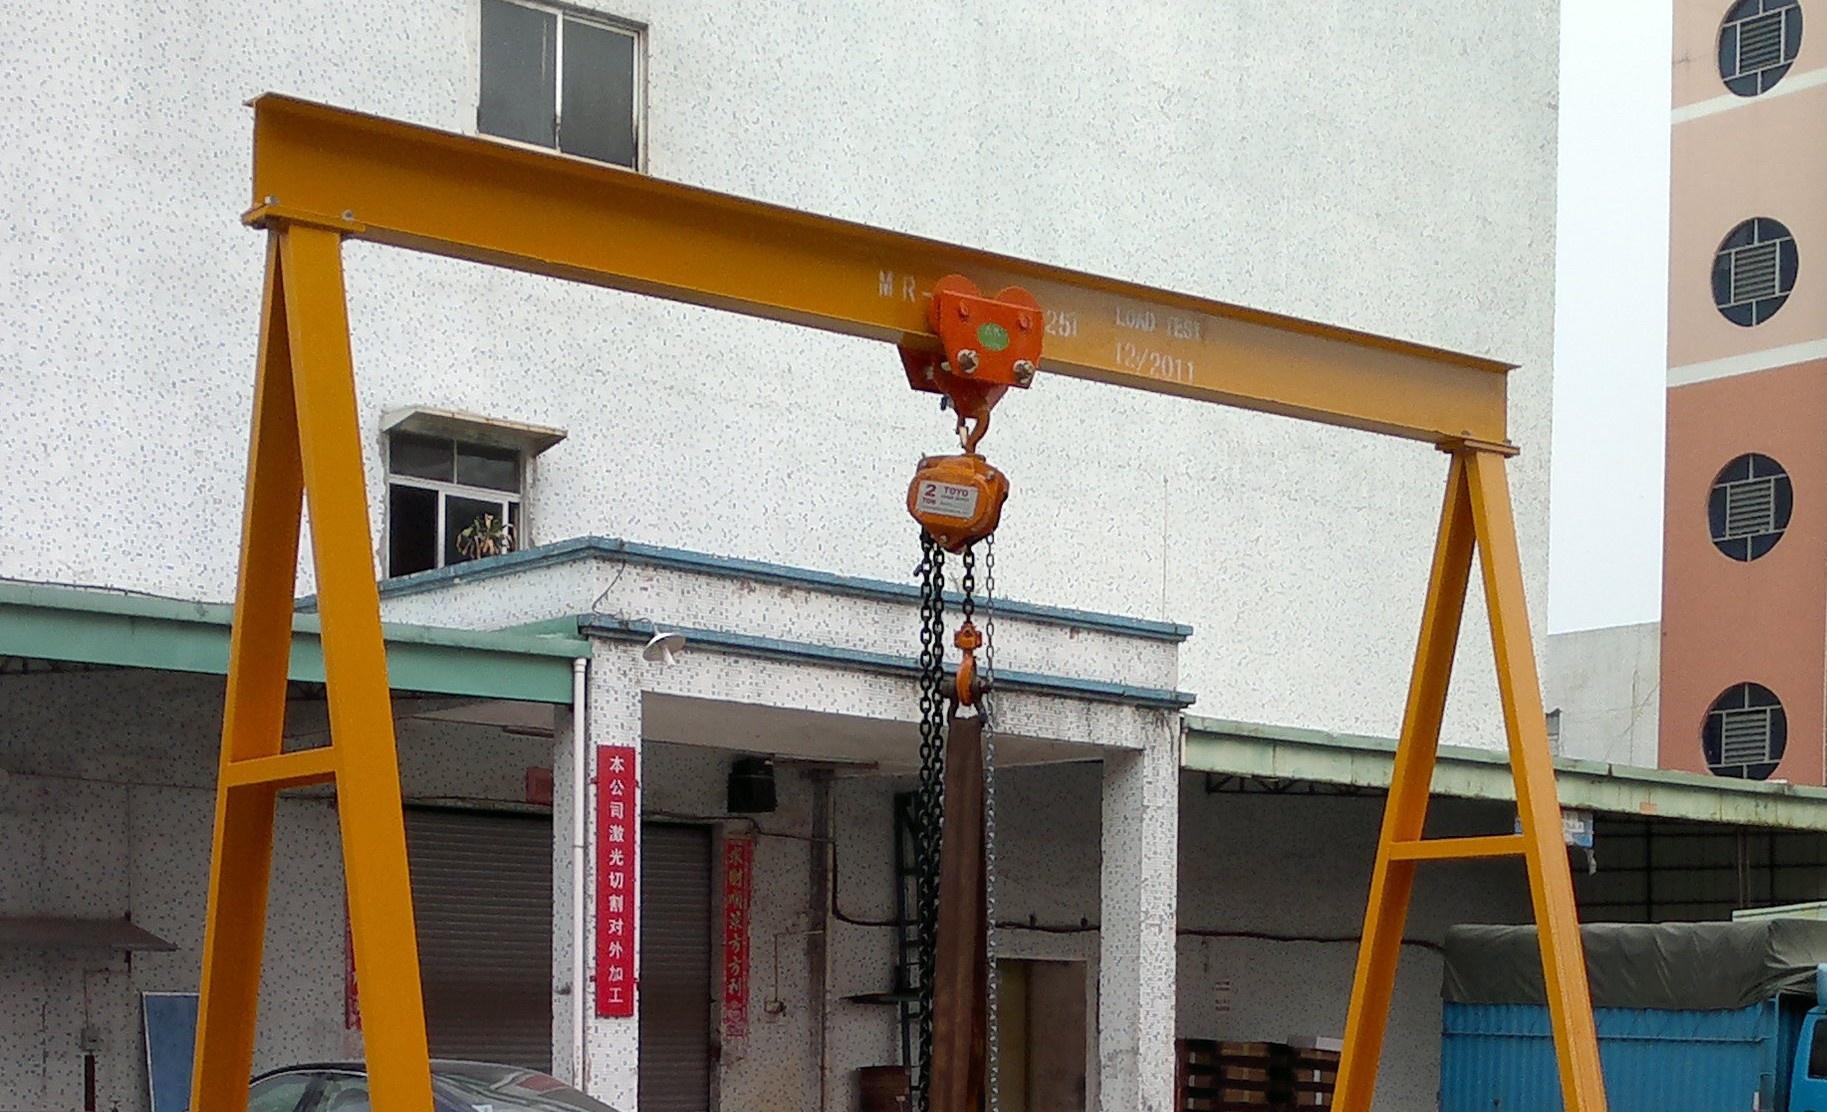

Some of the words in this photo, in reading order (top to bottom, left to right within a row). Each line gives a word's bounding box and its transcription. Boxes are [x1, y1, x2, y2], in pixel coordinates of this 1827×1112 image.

[1115, 341, 1196, 384] 12/2011
[924, 484, 936, 497] 2
[943, 486, 969, 498] TOYO
[608, 754, 625, 1004] 本公司激光切割对外加工
